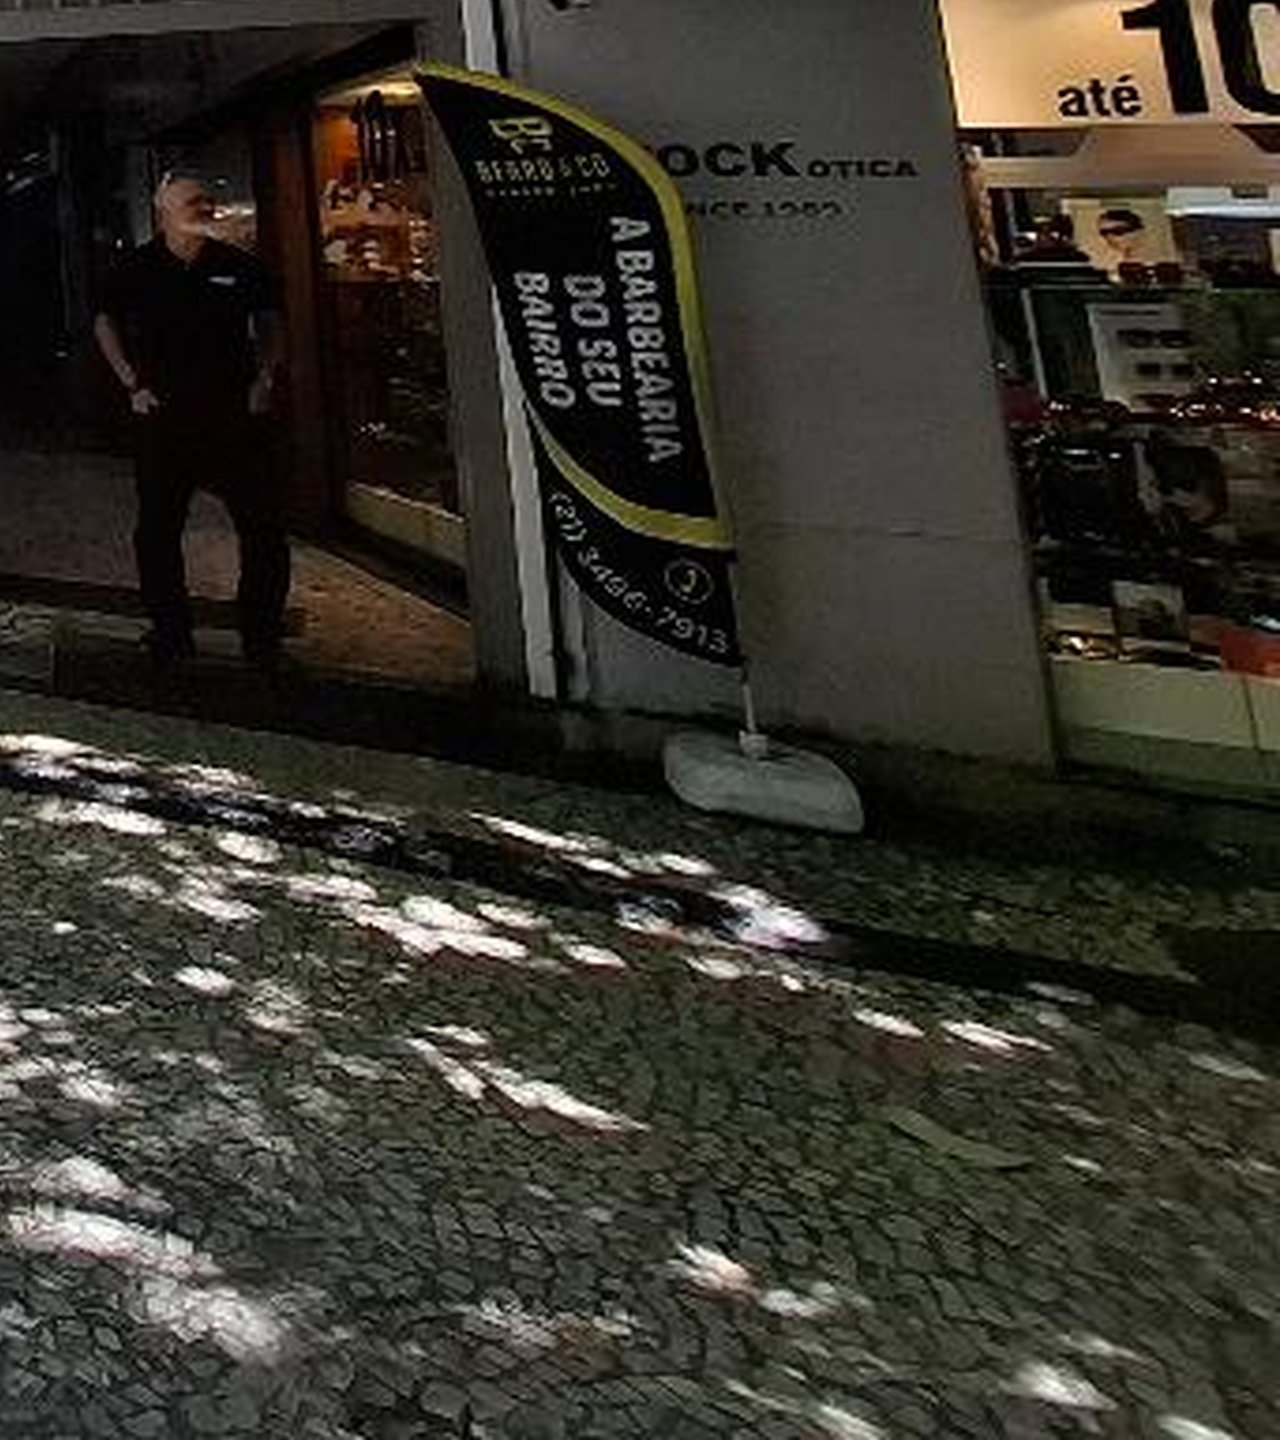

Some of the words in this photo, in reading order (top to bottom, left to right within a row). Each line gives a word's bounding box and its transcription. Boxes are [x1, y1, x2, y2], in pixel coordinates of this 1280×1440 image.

[1058, 73, 1143, 118] até
[656, 141, 800, 177] OCK
[610, 216, 651, 242] A
[686, 201, 749, 219] NCE
[563, 274, 610, 328] DO
[514, 271, 576, 410] BAIRRO
[615, 249, 683, 463] BARBEARIA
[577, 338, 622, 407] SEU
